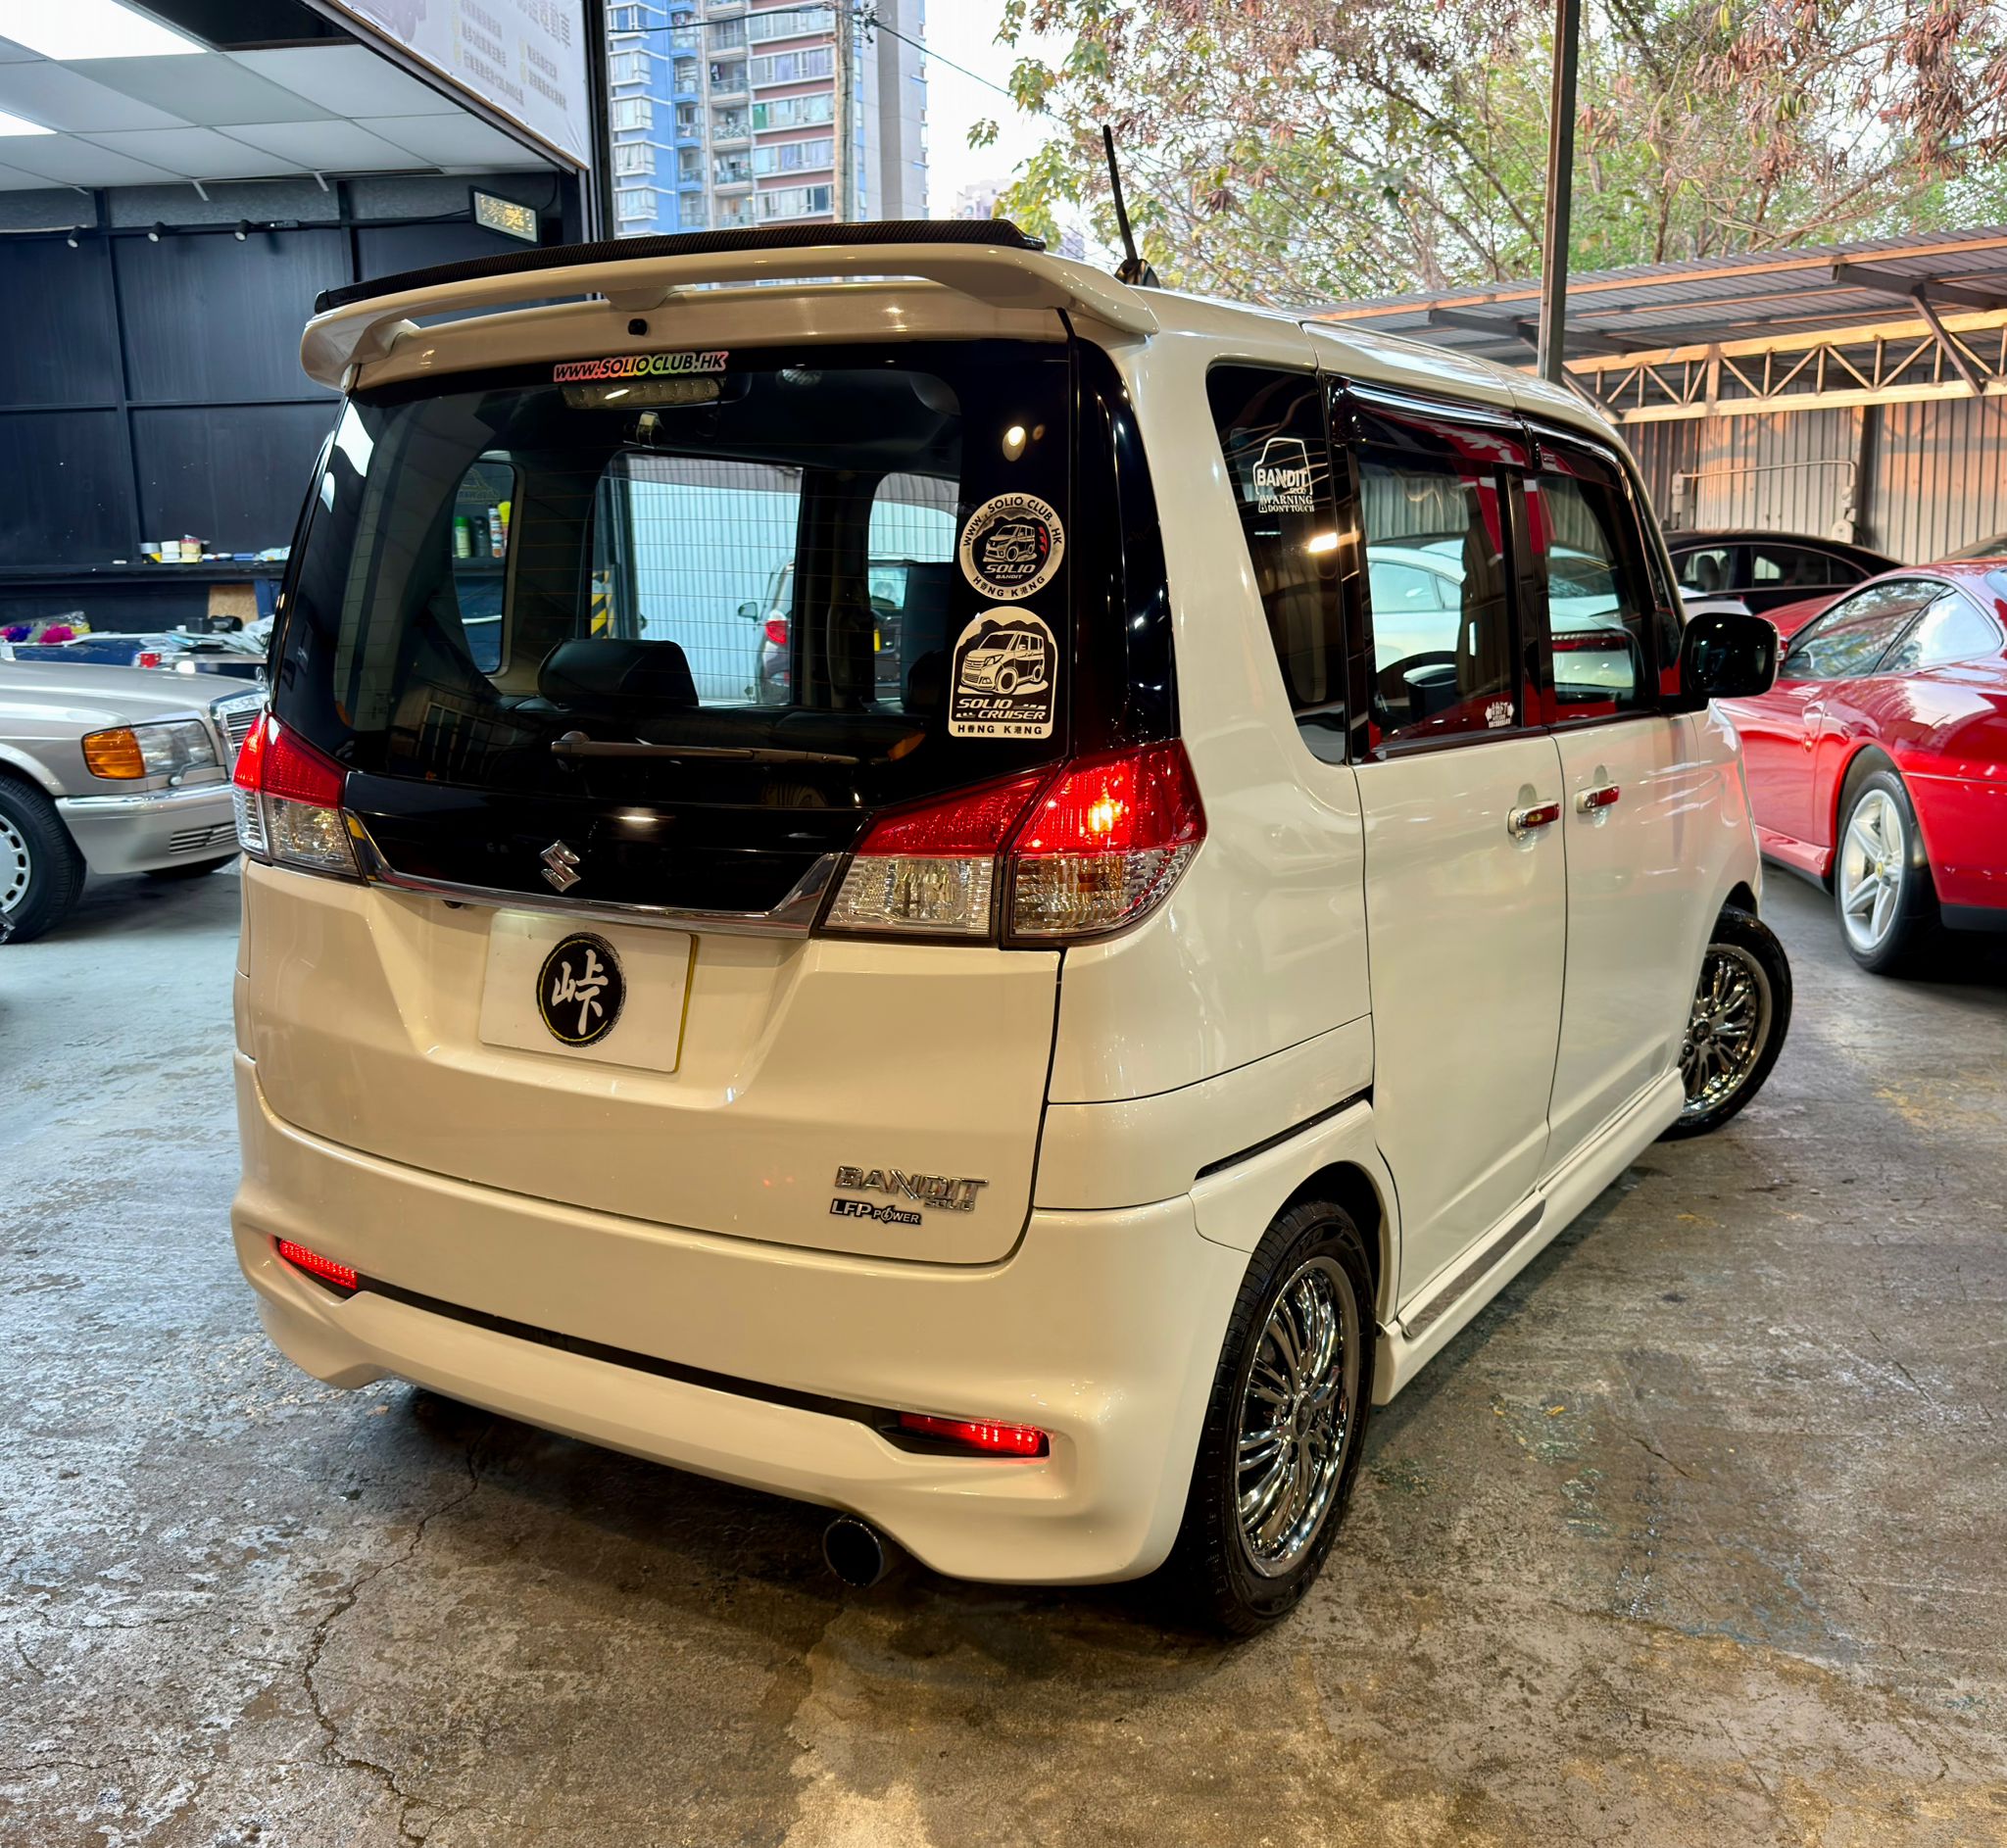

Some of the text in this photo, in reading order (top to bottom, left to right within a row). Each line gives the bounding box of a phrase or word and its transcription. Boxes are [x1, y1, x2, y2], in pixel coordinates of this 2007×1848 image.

[1256, 468, 1307, 488] BANDIT
[1262, 495, 1313, 505] WARNING
[984, 563, 1036, 574] SOLIO
[956, 699, 1013, 708] SOLIO
[977, 709, 1047, 719] CRUISER
[551, 948, 610, 1036] 峠
[834, 1166, 990, 1200] BANDIT
[831, 1200, 872, 1217] LFP
